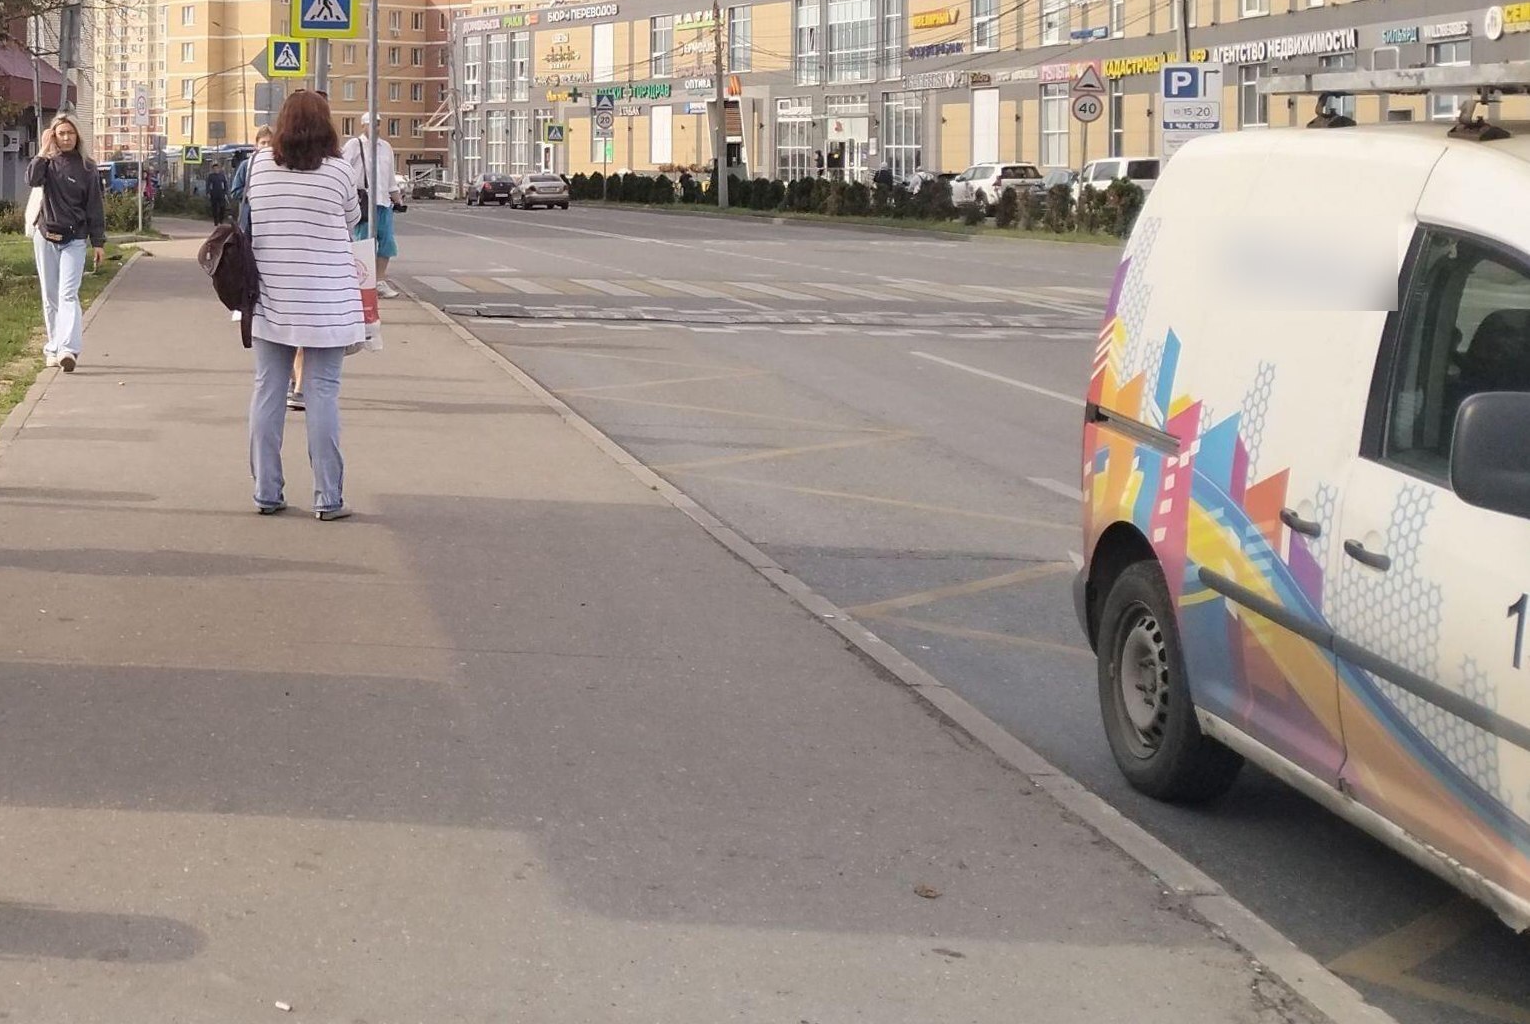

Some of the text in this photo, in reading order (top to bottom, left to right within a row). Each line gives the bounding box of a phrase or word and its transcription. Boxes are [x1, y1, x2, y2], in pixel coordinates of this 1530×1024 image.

[571, 4, 618, 20] ПЕРЕВОДОВ
[1382, 26, 1419, 44] БИЛЬЯРД
[1212, 28, 1356, 65] АГЕНТСТВО НЕДВИЖИМОСТИ
[1103, 51, 1166, 80] КАДАСТРОВЫЙ
[635, 83, 671, 99] ГОРЗДРАВ
[684, 79, 712, 89] ОПТИКА
[1171, 71, 1192, 95] P
[1078, 102, 1097, 115] 40
[1183, 107, 1192, 116] 15
[1196, 107, 1211, 117] 20
[600, 116, 610, 125] 20
[1507, 593, 1530, 669] 1
